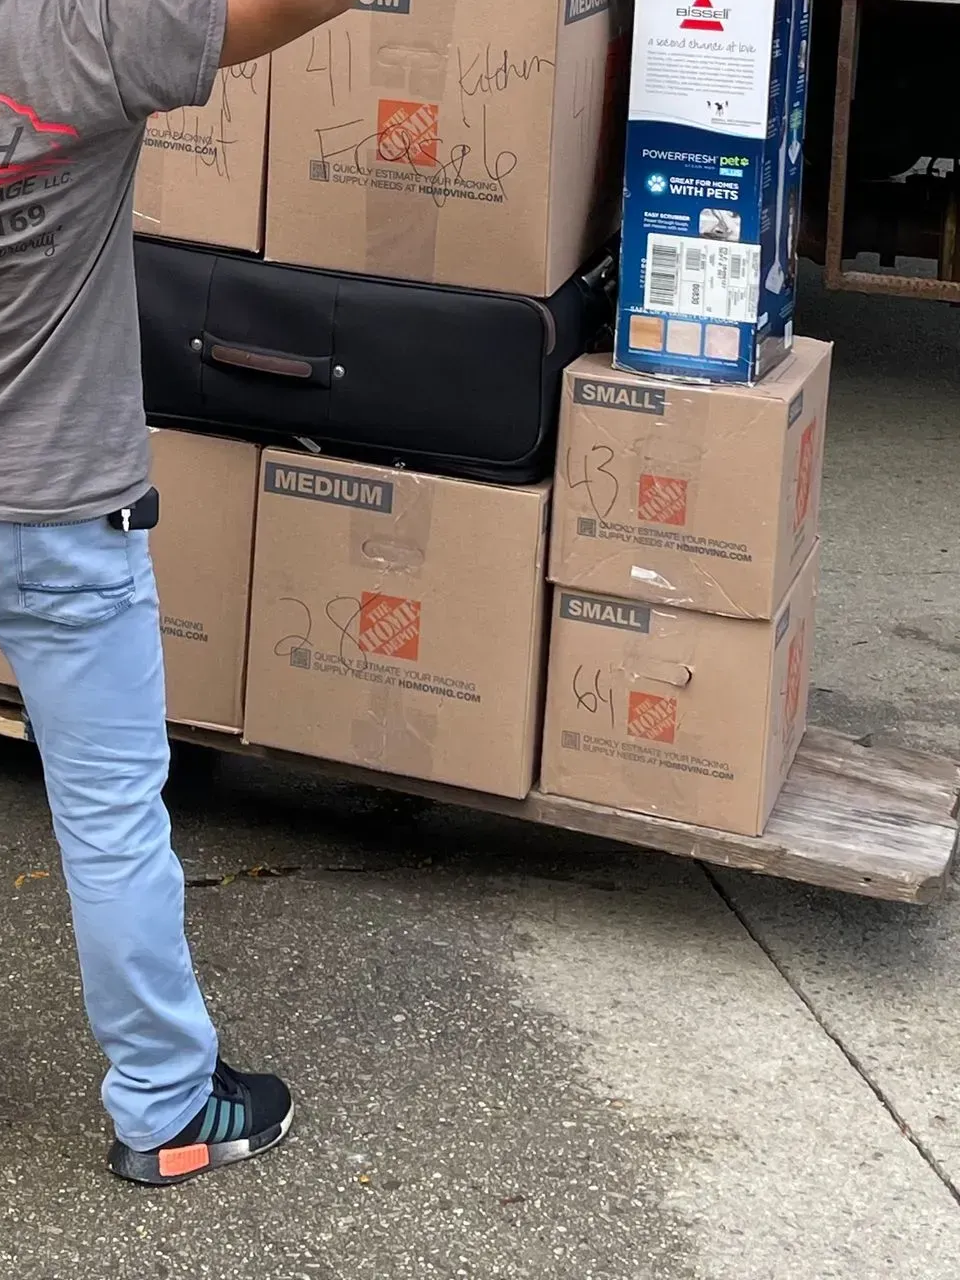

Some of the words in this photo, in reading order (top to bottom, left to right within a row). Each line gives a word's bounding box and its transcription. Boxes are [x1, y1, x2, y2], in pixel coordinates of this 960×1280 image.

[146, 127, 172, 139] YOUR
[642, 148, 716, 165] POWERFRESH
[720, 156, 740, 167] pet
[332, 163, 371, 175] QUICKLY
[375, 167, 420, 183] ESTIMATE
[423, 174, 451, 186] YOUR
[453, 178, 497, 192] PACKING
[332, 174, 368, 186] SUPPLY
[370, 180, 402, 192] NEEDS
[404, 185, 415, 194] AT
[418, 185, 503, 203] HDMOVING.COM
[670, 176, 693, 185] GREAT
[695, 179, 711, 187] FOR
[712, 181, 739, 190] HOMES
[670, 183, 703, 197] WITH
[706, 188, 739, 201] PETS
[582, 384, 656, 409] SMALL
[274, 468, 383, 507] MEDIUM
[599, 521, 635, 535] QUICKLY
[637, 527, 680, 542] ESTIMATE
[681, 534, 707, 547] YOUR
[707, 538, 747, 553] PACKING
[599, 531, 631, 543] SUPPLY
[633, 536, 663, 549] NEEDS
[664, 541, 675, 550] AT
[676, 543, 752, 562] HDMOVING.COM
[359, 599, 420, 653] HOME
[368, 601, 390, 623] THE
[568, 599, 641, 628] SMALL
[160, 625, 208, 642] VING.COM
[382, 624, 420, 655] DEPOT
[313, 651, 354, 670] QUICKLY
[356, 658, 402, 678] ESTIMATE
[404, 668, 432, 683] YOUR
[433, 674, 476, 692] PACKING
[313, 662, 350, 677] SUPPLY
[351, 669, 384, 685] NEEDS
[385, 674, 397, 686] AT
[398, 679, 481, 703] HDMOVING.COM
[582, 734, 620, 749] QUICKLY
[621, 742, 662, 758] ESTIMATE
[664, 751, 690, 764] YOUR
[690, 756, 729, 771] PACKING
[582, 744, 615, 758] SUPPLY
[616, 751, 646, 764] NEEDS
[647, 756, 658, 765] AT
[658, 759, 734, 781] HDMOVING.COM
